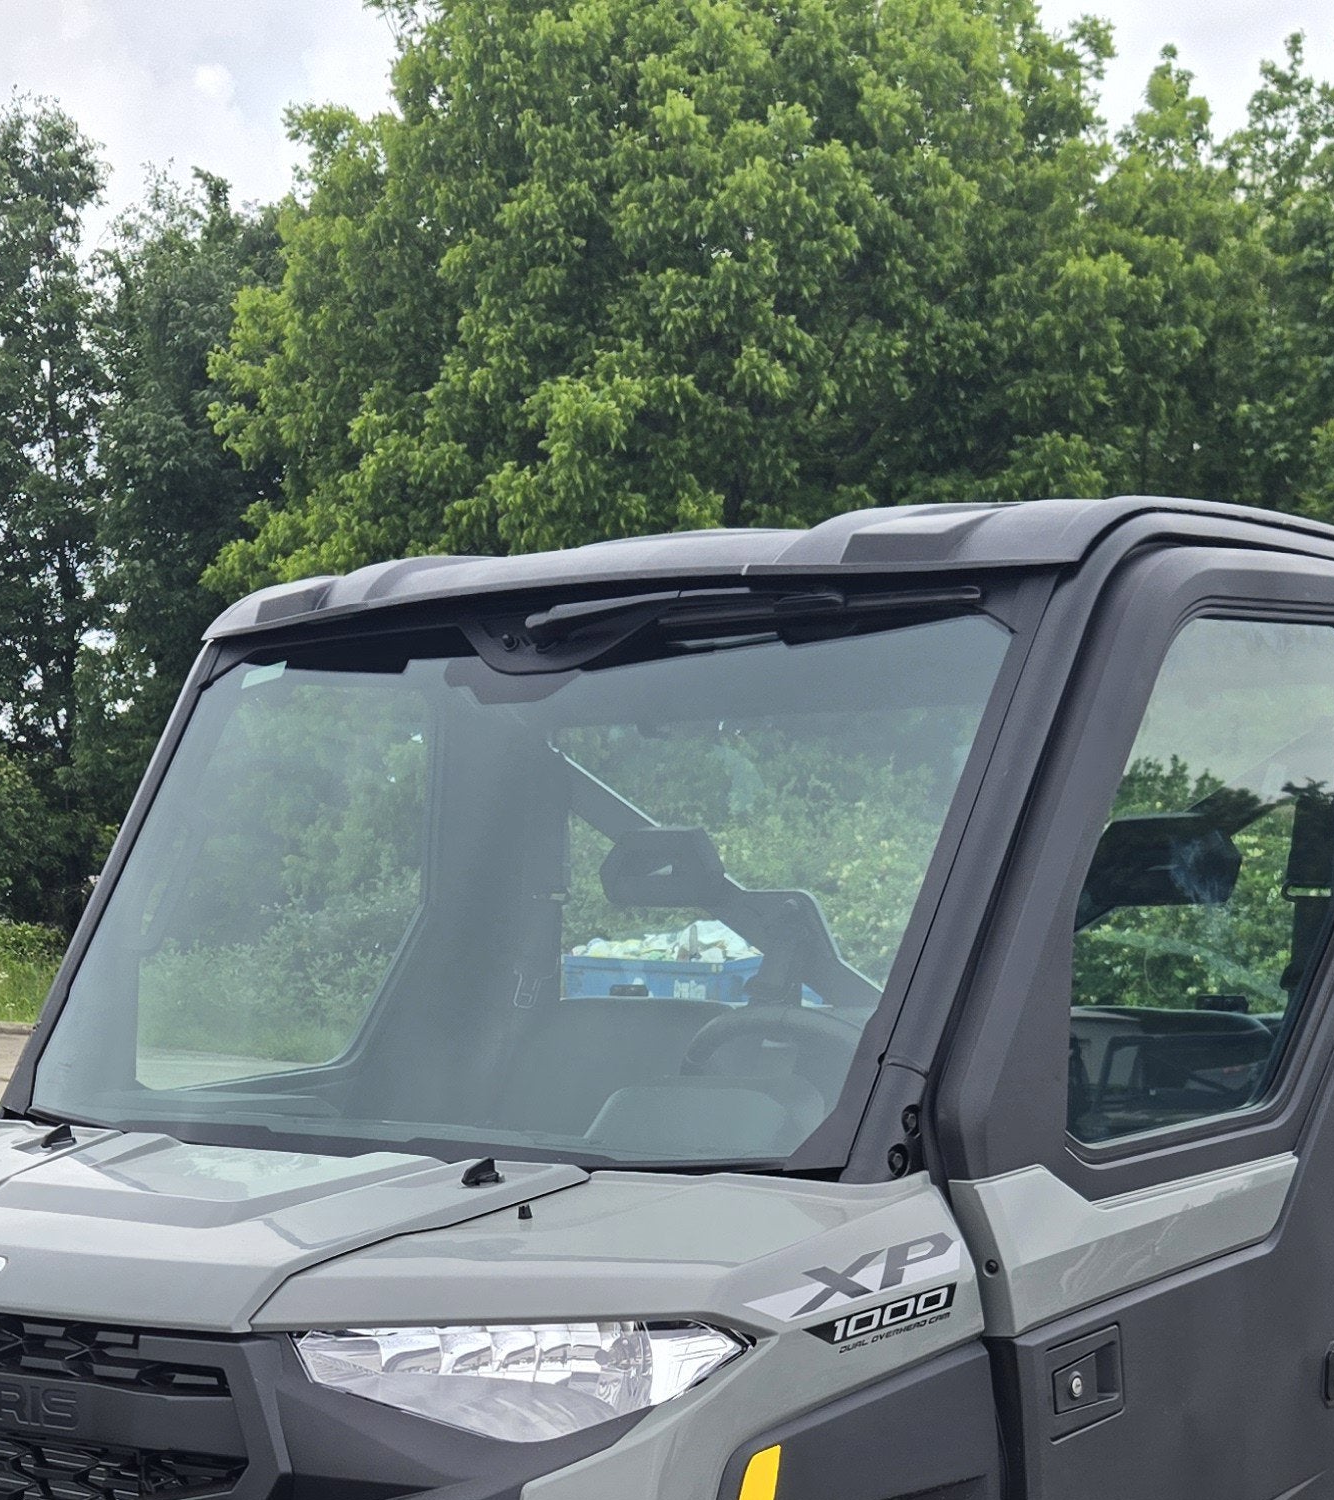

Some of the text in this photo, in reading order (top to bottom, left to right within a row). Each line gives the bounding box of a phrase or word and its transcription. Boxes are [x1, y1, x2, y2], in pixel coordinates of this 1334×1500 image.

[789, 1232, 955, 1318] XP
[833, 1287, 949, 1342] 1000
[839, 1311, 951, 1354] DUAL OVERHEAD CAM
